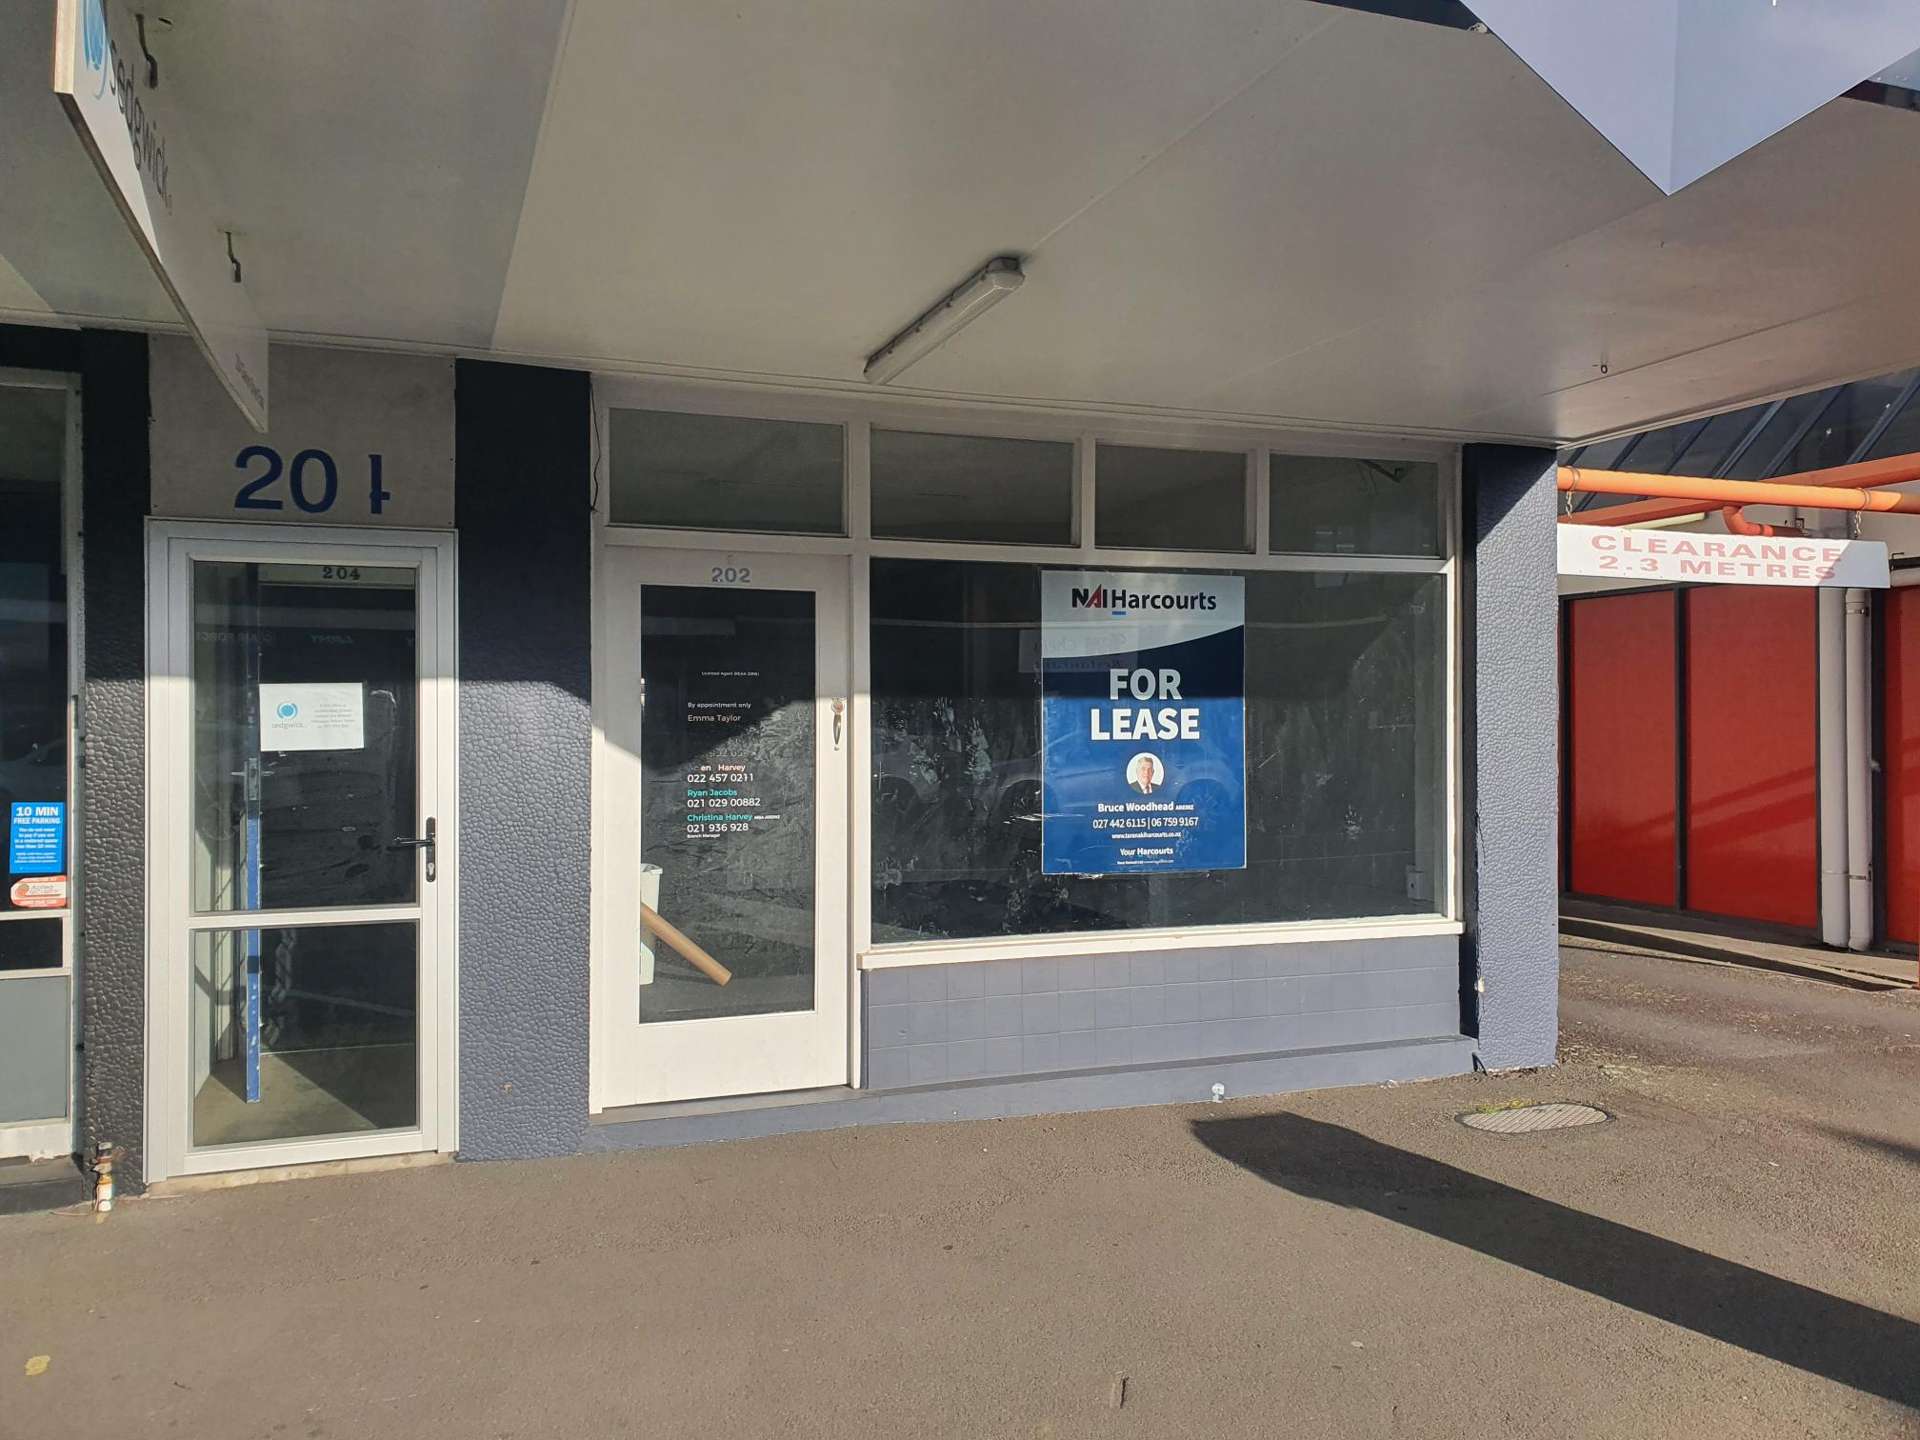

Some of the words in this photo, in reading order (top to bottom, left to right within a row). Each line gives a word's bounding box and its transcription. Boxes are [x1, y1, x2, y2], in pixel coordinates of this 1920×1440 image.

[1591, 535, 1841, 562] CLEARANCE
[1599, 555, 1660, 573] 2.3
[1679, 559, 1836, 580] METRES
[322, 566, 361, 580] 204
[711, 567, 751, 583] 202
[1072, 584, 1107, 609] NAI
[1112, 589, 1216, 610] Harcourts
[1110, 668, 1182, 700] FOR
[687, 714, 715, 722] Emma
[717, 714, 742, 723] Taylor
[1091, 708, 1200, 740] LEASE
[718, 764, 746, 772] Harvey
[687, 774, 706, 782] 022
[709, 774, 728, 782] 457
[730, 773, 753, 782] 0211
[687, 789, 708, 797] Ryan
[687, 799, 705, 808] 021
[708, 799, 728, 807] 029
[730, 798, 761, 807] 00882
[1098, 803, 1125, 813] Bruce
[1125, 801, 1174, 812] Woodhead
[16, 806, 32, 816] 10
[35, 806, 59, 816] MIN
[14, 817, 32, 825] FREE
[32, 817, 61, 825] PARKING
[687, 814, 723, 822] Christina
[725, 814, 752, 822] Harvey
[1092, 819, 1108, 829] 027
[1109, 819, 1126, 829] 442
[1126, 818, 1146, 828] 6115
[1151, 817, 1162, 827] 06
[1164, 817, 1178, 827] 759
[1178, 816, 1199, 827] 9167
[687, 824, 705, 833] 021
[708, 823, 728, 832] 936
[730, 823, 749, 832] 928
[1119, 848, 1136, 856] Your
[1136, 847, 1174, 856] Harcourts
